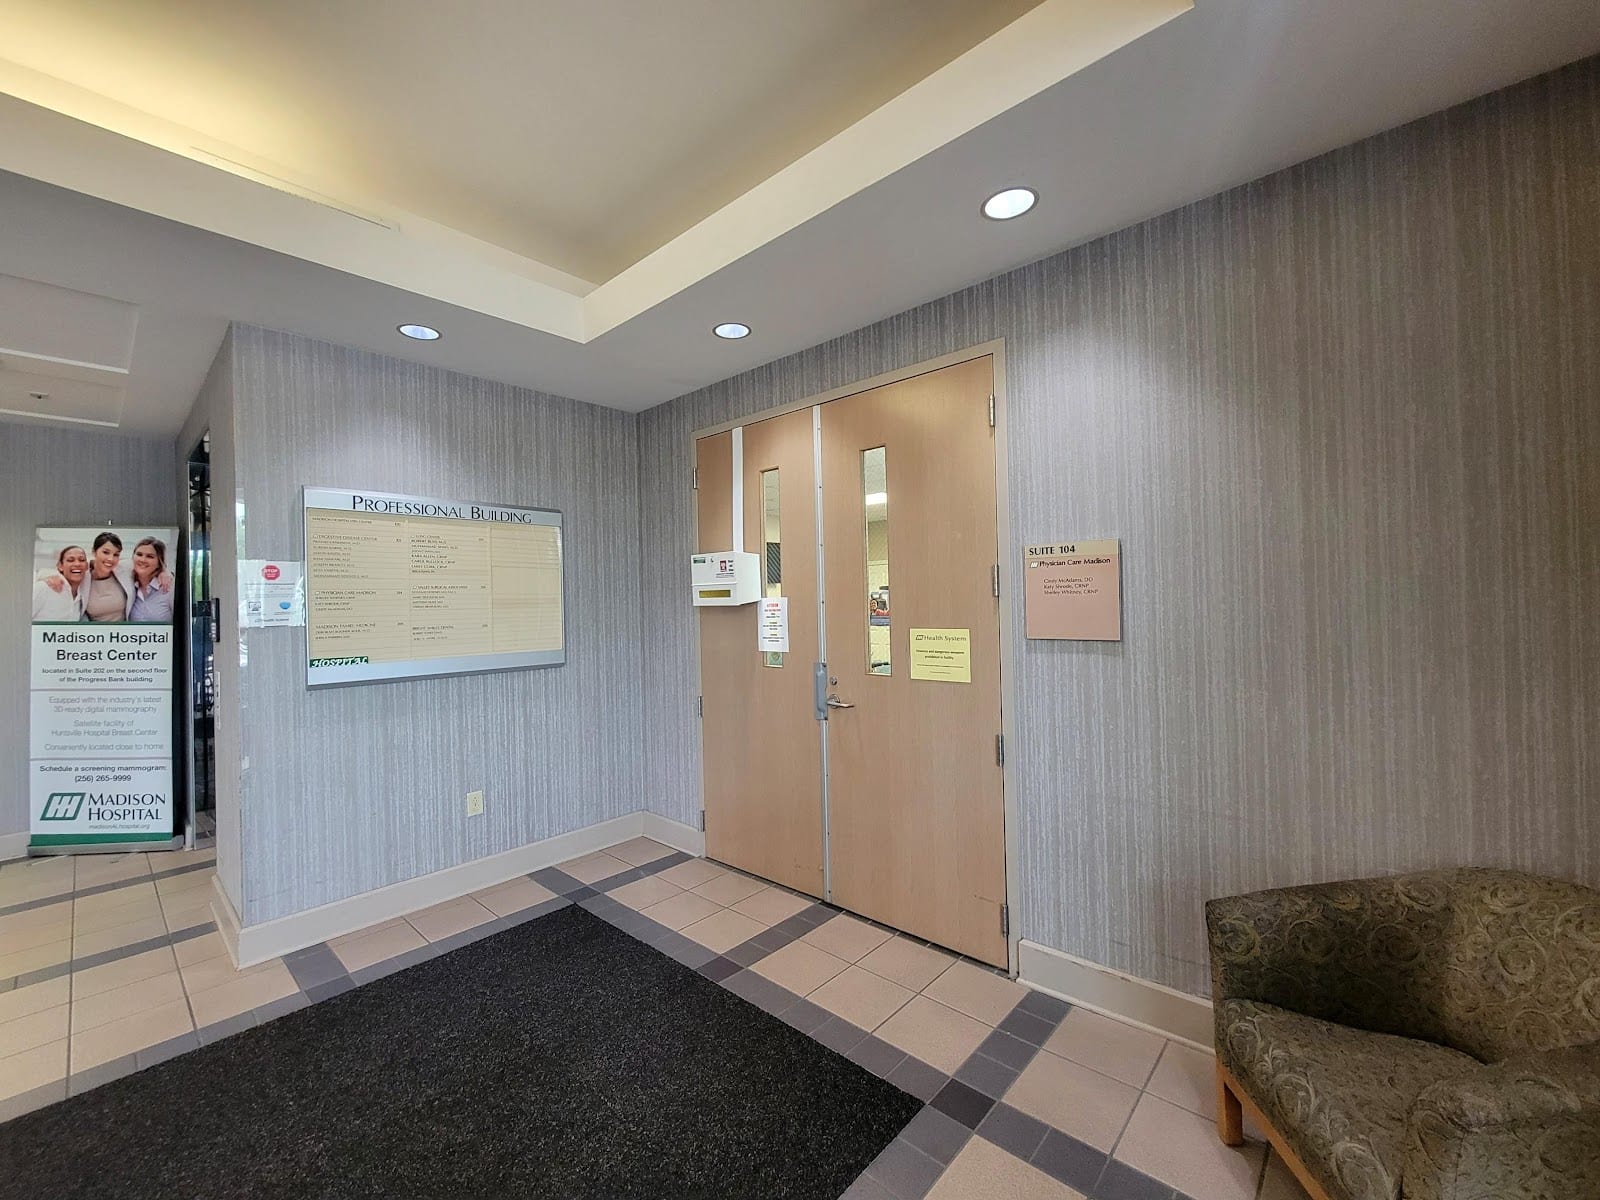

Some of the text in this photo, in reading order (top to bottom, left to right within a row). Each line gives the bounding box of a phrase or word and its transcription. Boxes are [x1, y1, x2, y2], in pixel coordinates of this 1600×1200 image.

[352, 495, 532, 524] PROFESSIONAL BUILDING
[1028, 545, 1076, 556] SUITE 104
[1039, 560, 1066, 568] Physician
[1083, 557, 1111, 565] Madison
[42, 631, 169, 645] Madison Hospital
[944, 635, 967, 643] System
[56, 649, 157, 661] Breast Center
[311, 656, 368, 667] HOSPITAL
[48, 696, 81, 704] Equipped
[85, 705, 105, 713] digital
[106, 705, 157, 713] mammography
[83, 729, 111, 737] Hospital
[44, 743, 87, 751] Conveniently
[74, 774, 132, 783] (256) 265-9999
[88, 792, 166, 806] MADISON
[88, 807, 163, 821] HOSPITAL
